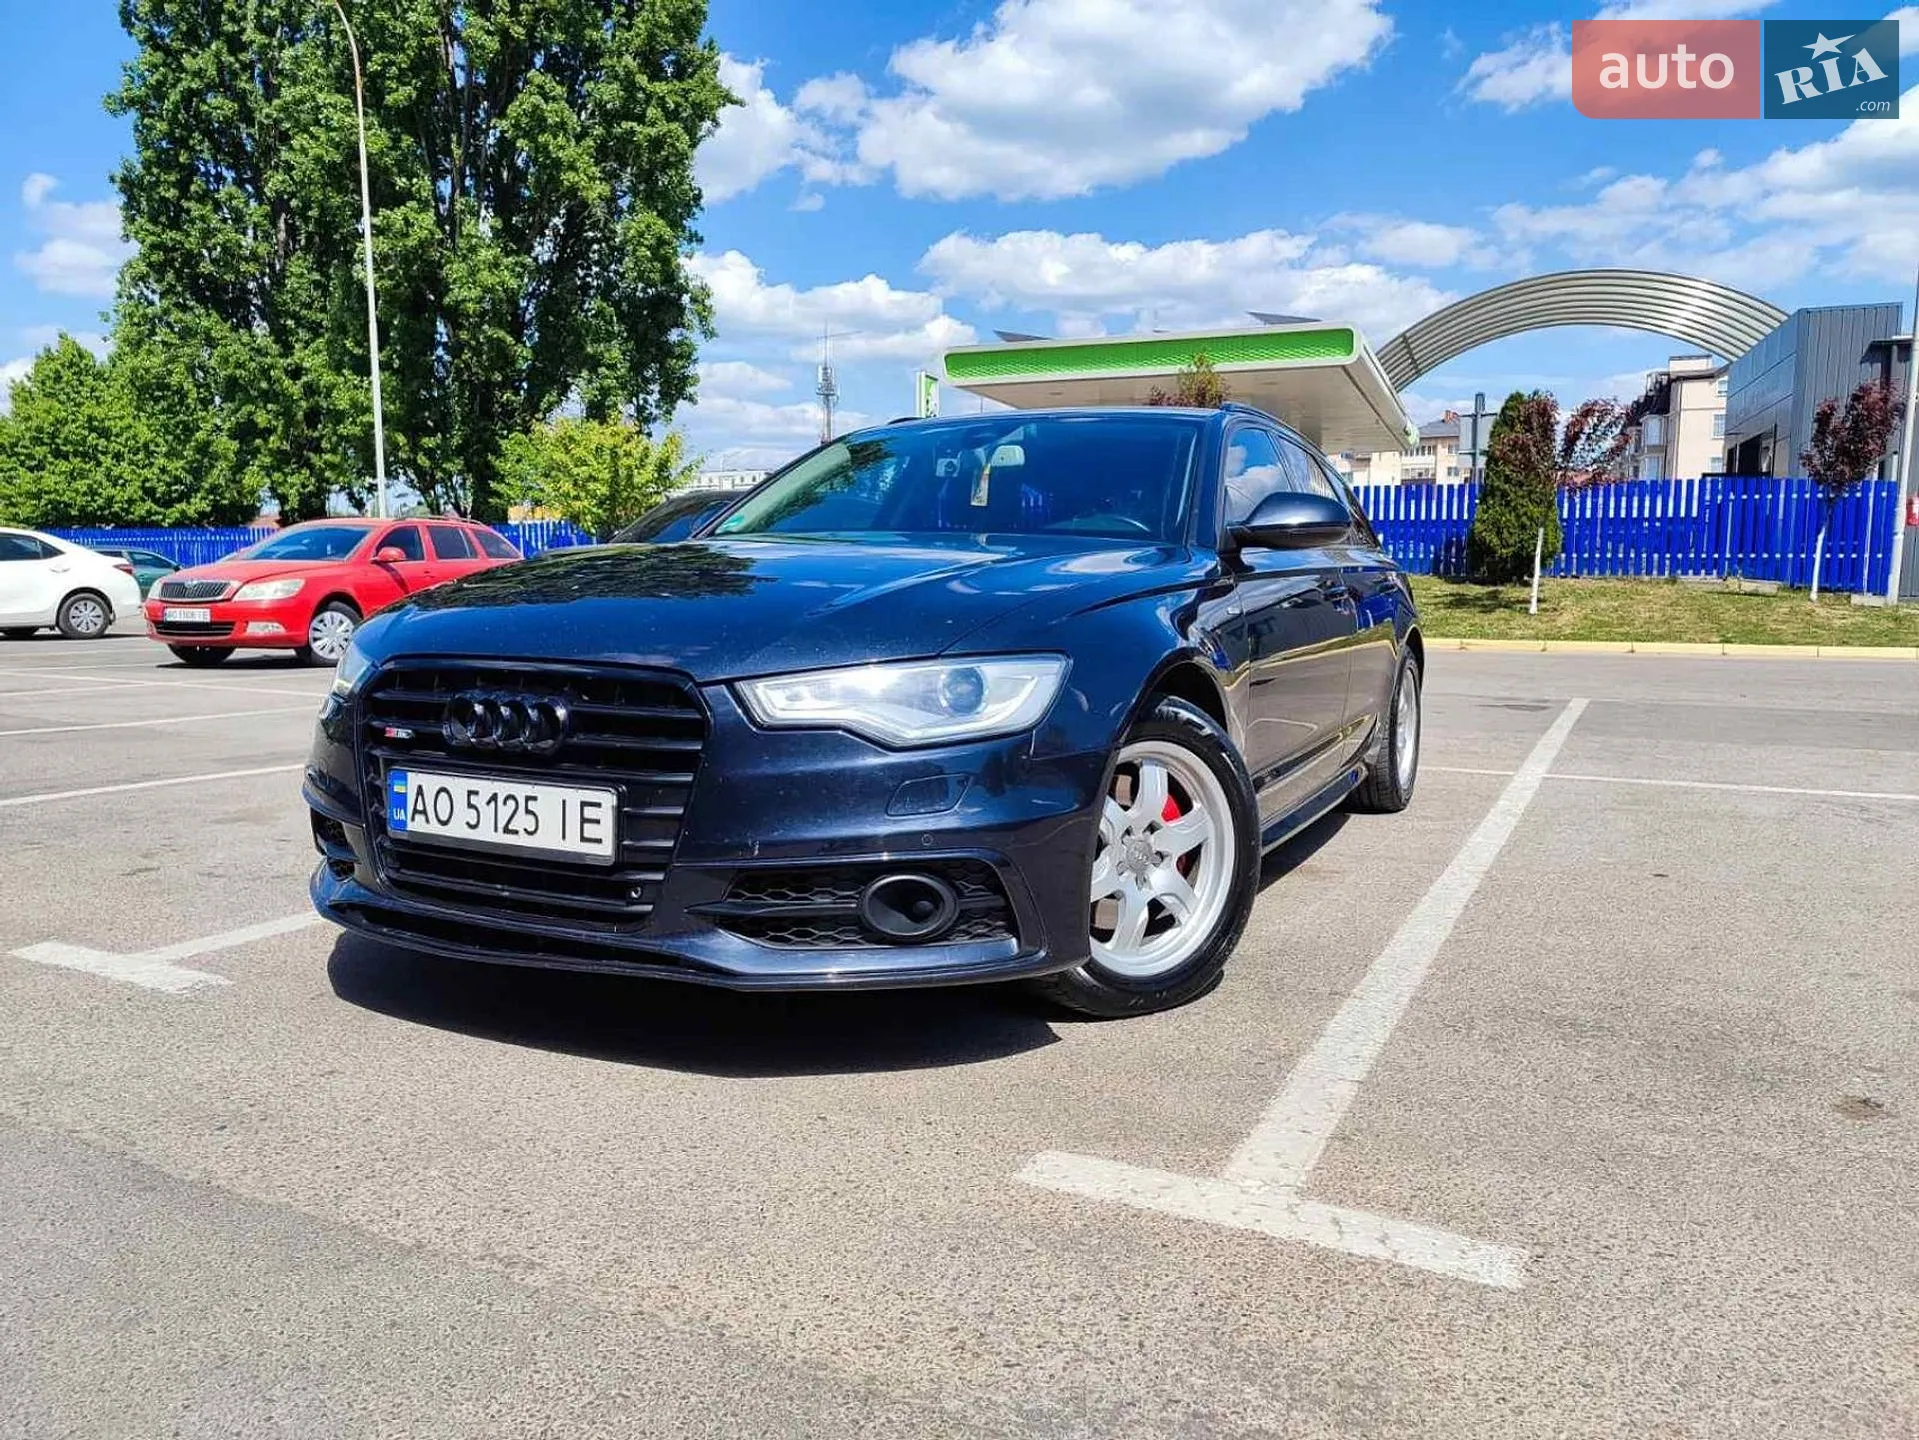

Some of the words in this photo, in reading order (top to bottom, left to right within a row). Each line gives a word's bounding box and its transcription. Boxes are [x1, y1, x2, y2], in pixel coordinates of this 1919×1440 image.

[393, 808, 406, 821] UA
[411, 784, 454, 826] AO
[465, 790, 539, 836] 5125
[561, 799, 603, 844] IE
